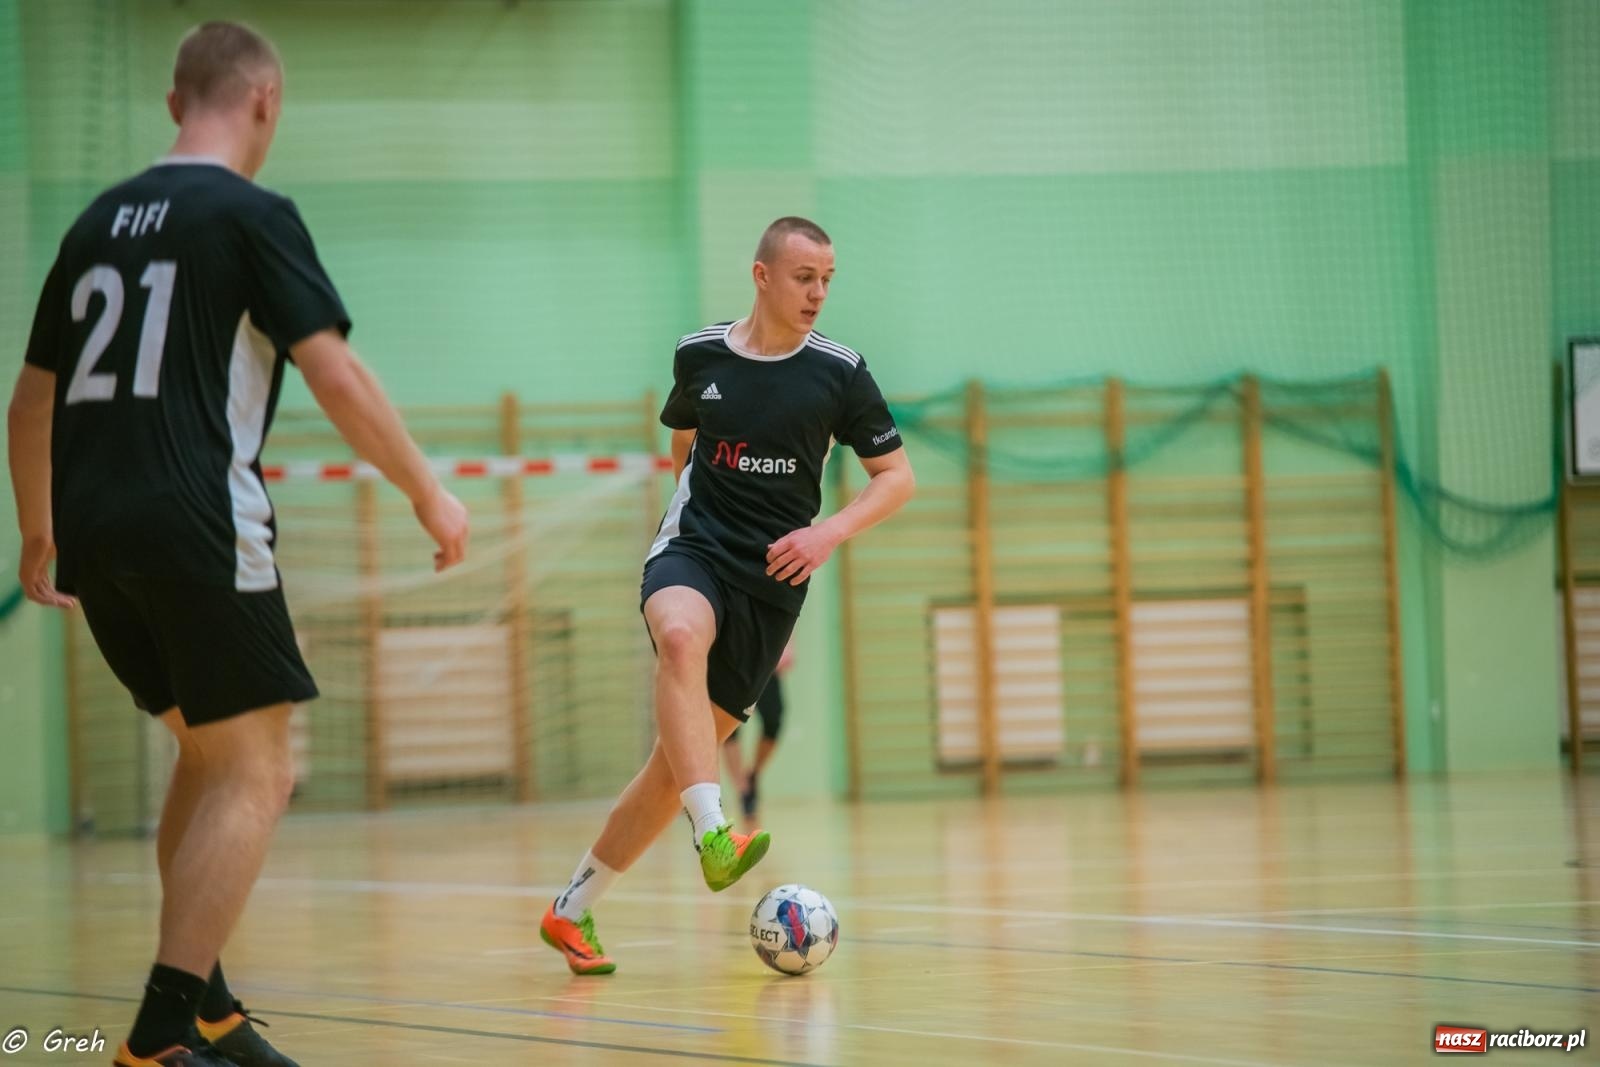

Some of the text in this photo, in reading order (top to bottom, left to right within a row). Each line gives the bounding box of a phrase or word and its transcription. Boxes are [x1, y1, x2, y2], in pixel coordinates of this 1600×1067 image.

[111, 198, 169, 238] FIFI
[65, 258, 177, 405] 21
[711, 441, 797, 474] Nexans
